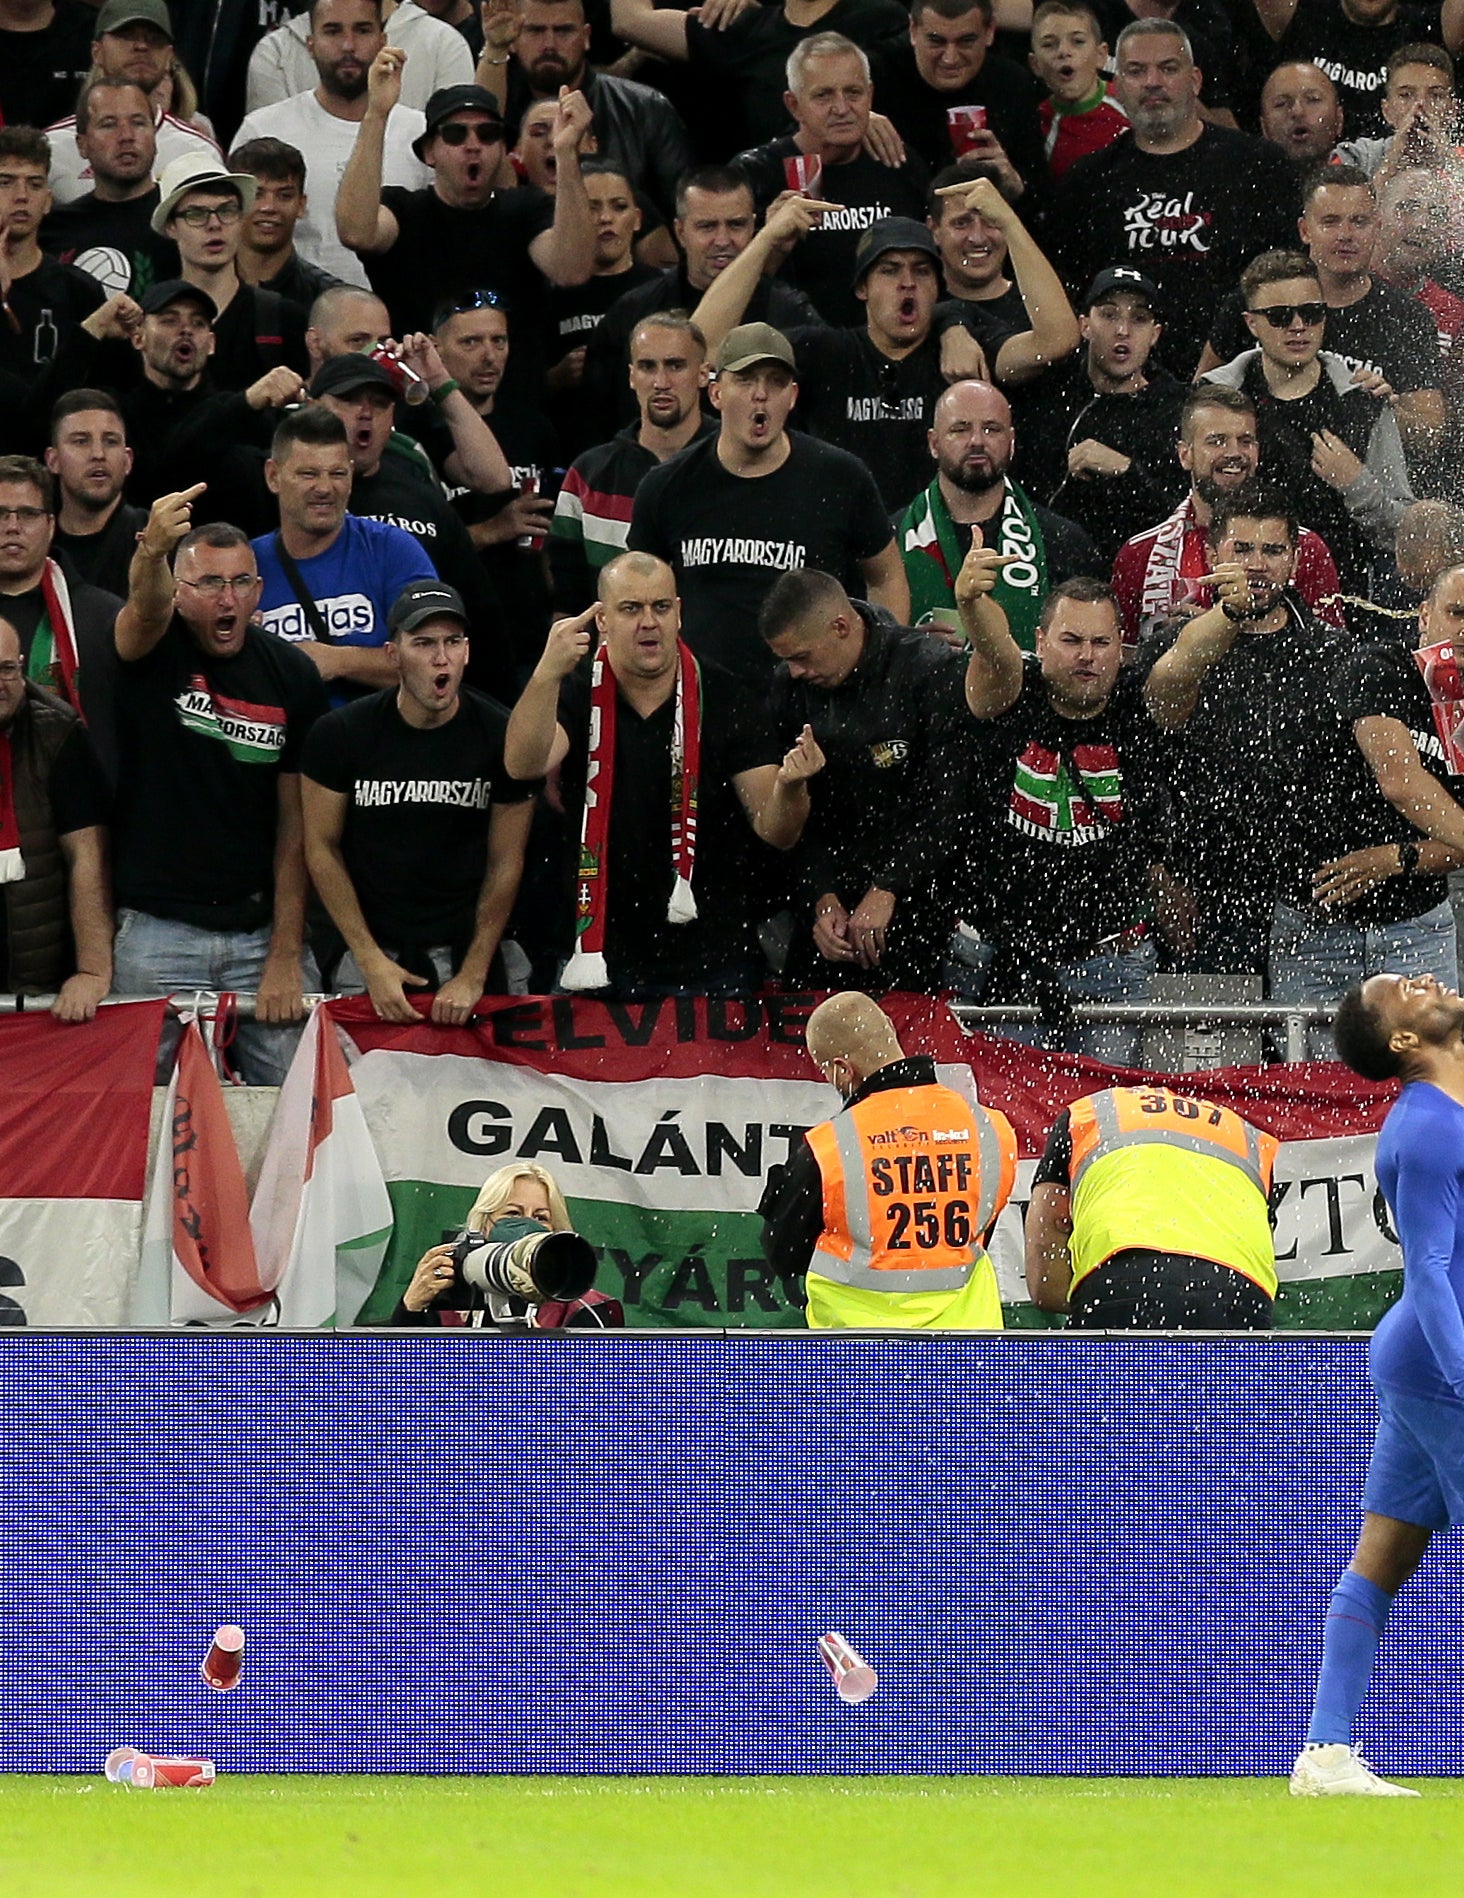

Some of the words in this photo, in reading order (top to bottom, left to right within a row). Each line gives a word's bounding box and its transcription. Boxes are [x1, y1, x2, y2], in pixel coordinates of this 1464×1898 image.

[681, 538, 806, 569] MAGYARORSZÁG
[355, 778, 491, 810] MAGYARORSZÁG
[871, 1153, 972, 1196] STAFF
[886, 1200, 970, 1250] 256
